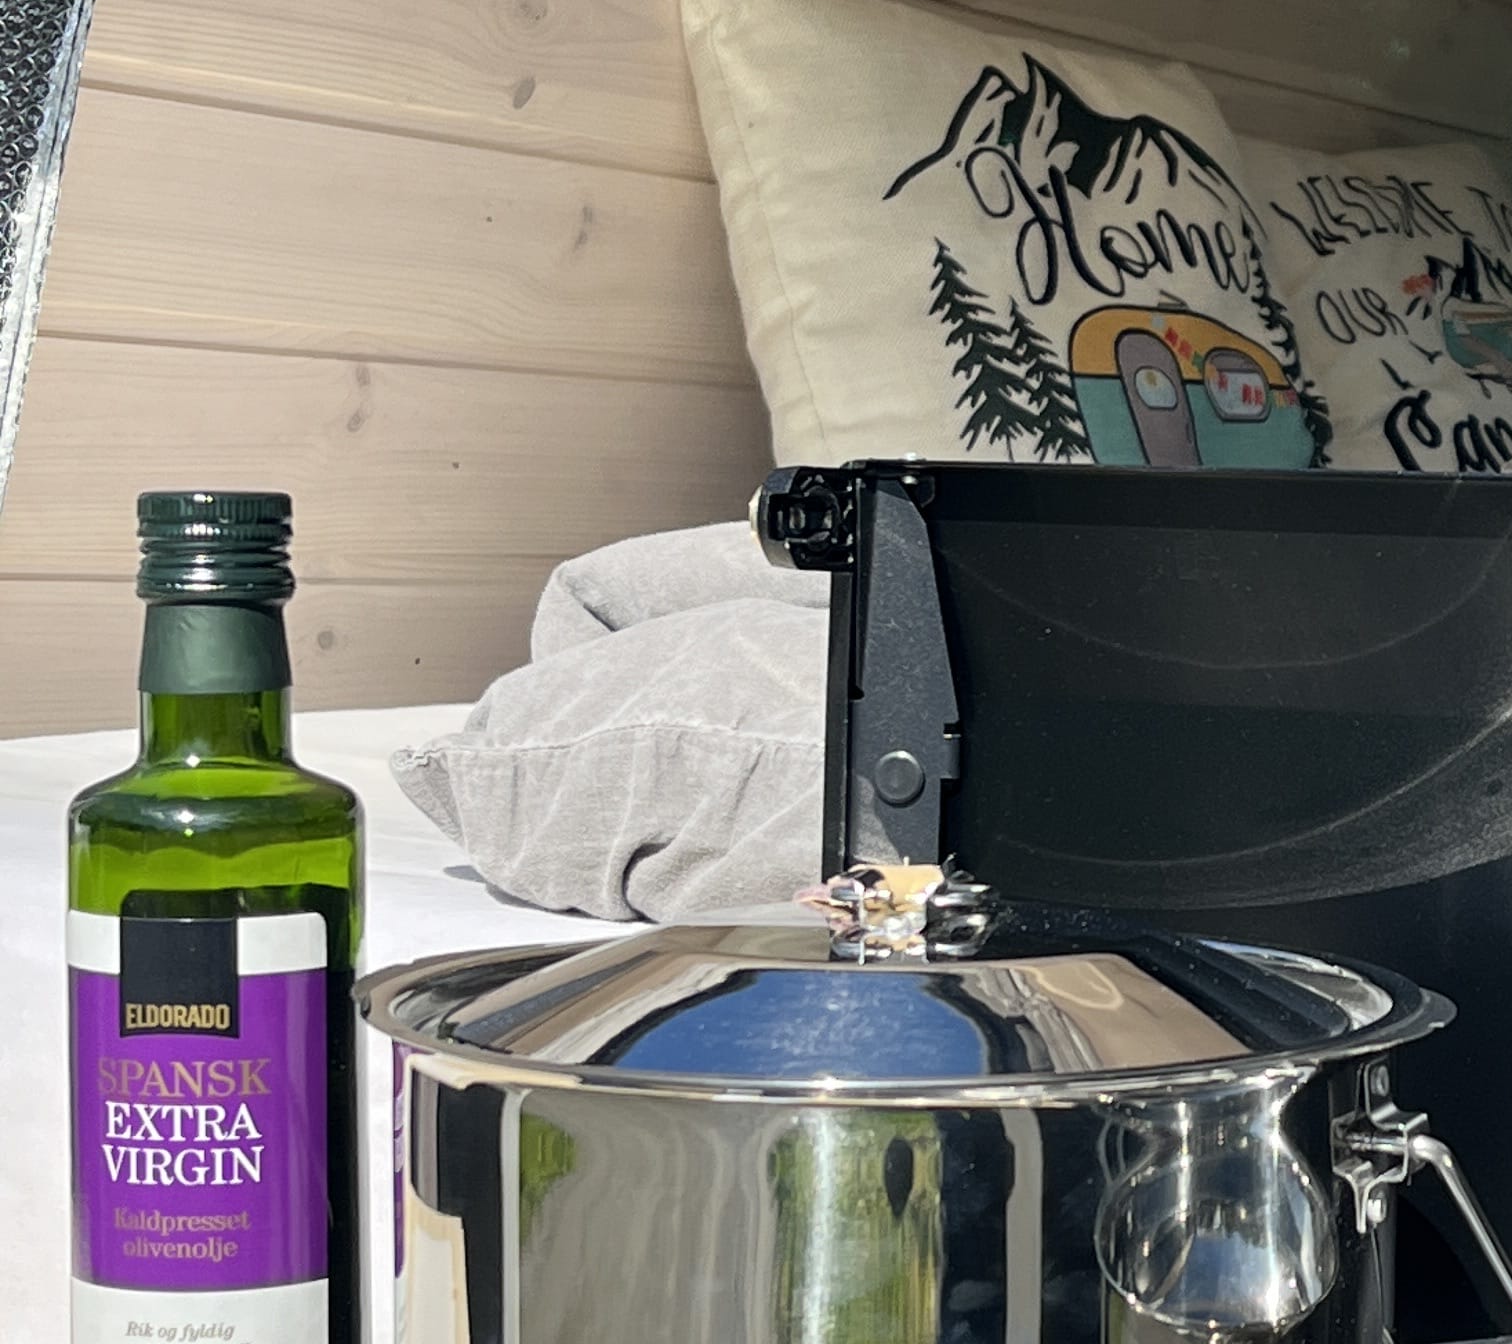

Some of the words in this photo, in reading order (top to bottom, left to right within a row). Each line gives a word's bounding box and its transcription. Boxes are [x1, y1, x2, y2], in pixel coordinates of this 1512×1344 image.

[964, 146, 1251, 306] Home
[1315, 287, 1409, 344] OUR
[125, 1003, 230, 1030] ELDORADO
[99, 1059, 271, 1098] SPANSK
[105, 1101, 262, 1140] EXTRA
[102, 1144, 265, 1185] VIRGIN
[113, 1207, 251, 1235] Kaldpresset
[123, 1235, 239, 1263] olivenolje
[125, 1321, 153, 1337] Rik
[158, 1327, 177, 1341] og
[178, 1322, 235, 1342] fyldig
